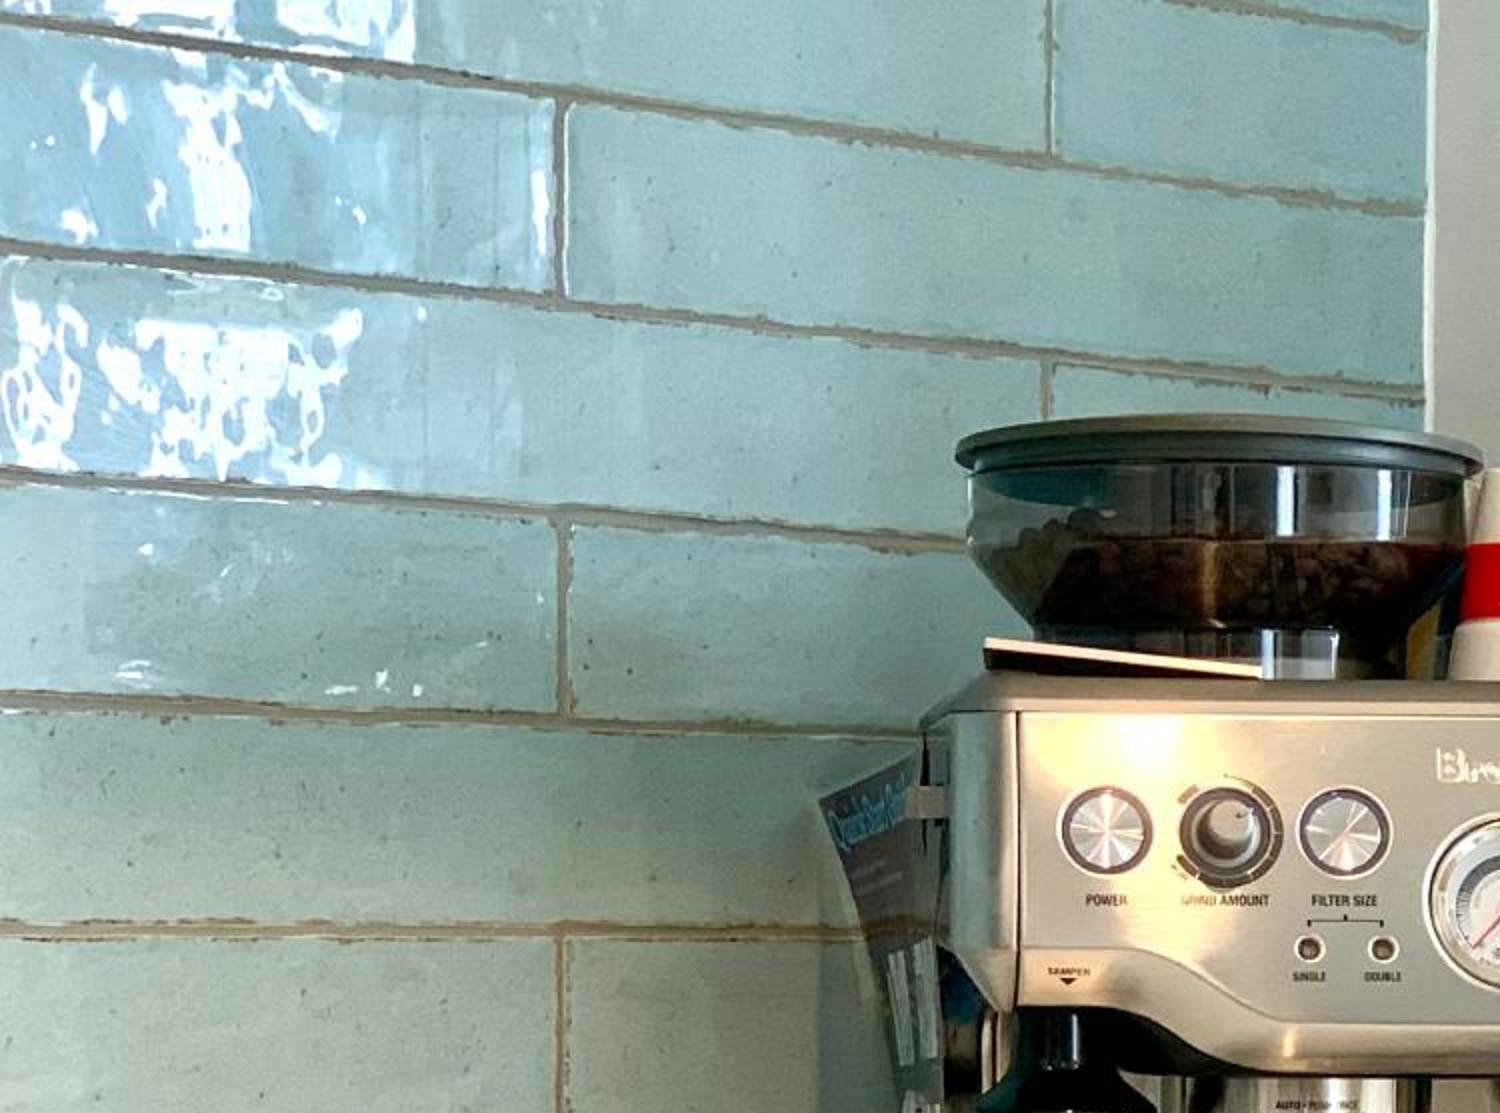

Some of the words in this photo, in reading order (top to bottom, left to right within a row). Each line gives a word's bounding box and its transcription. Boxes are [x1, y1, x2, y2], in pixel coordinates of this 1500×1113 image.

[1085, 894, 1128, 907] POWER
[1219, 894, 1269, 907] AMOUNT
[1311, 894, 1350, 907] FILTER
[1352, 894, 1377, 907] SIZE
